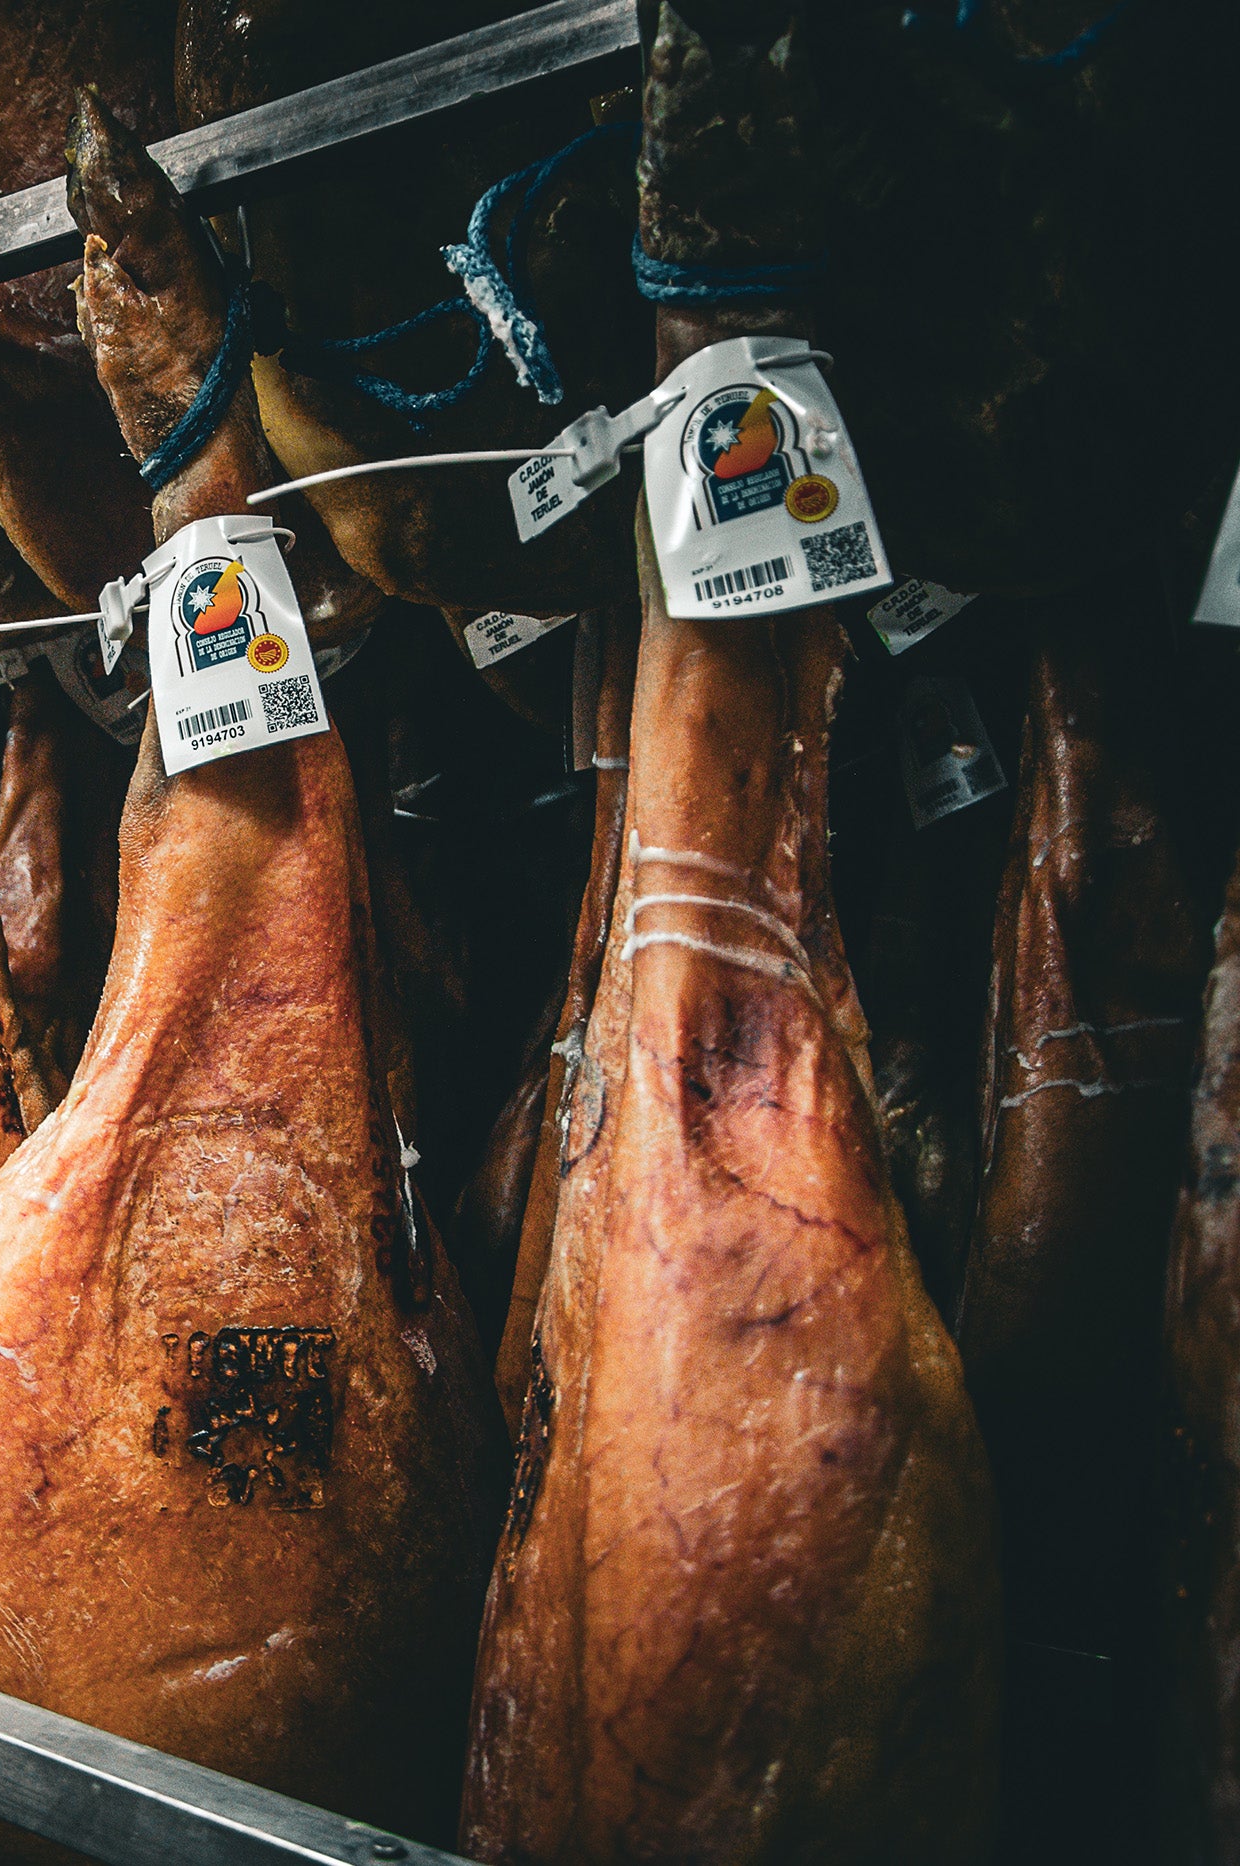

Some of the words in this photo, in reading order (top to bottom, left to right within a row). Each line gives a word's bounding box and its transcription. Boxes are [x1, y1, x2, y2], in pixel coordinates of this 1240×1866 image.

[535, 485, 548, 503] DE
[530, 493, 563, 522] TERUEL
[712, 584, 785, 609] 9194708
[903, 607, 943, 636] TERUEL
[906, 605, 924, 620] DE
[195, 635, 217, 648] CONSEJO
[217, 627, 245, 640] REGULADOR
[488, 634, 522, 655] TERUEL
[494, 630, 508, 642] DE
[198, 648, 206, 657] DE
[210, 653, 218, 661] DE
[191, 725, 246, 751] 9194703
